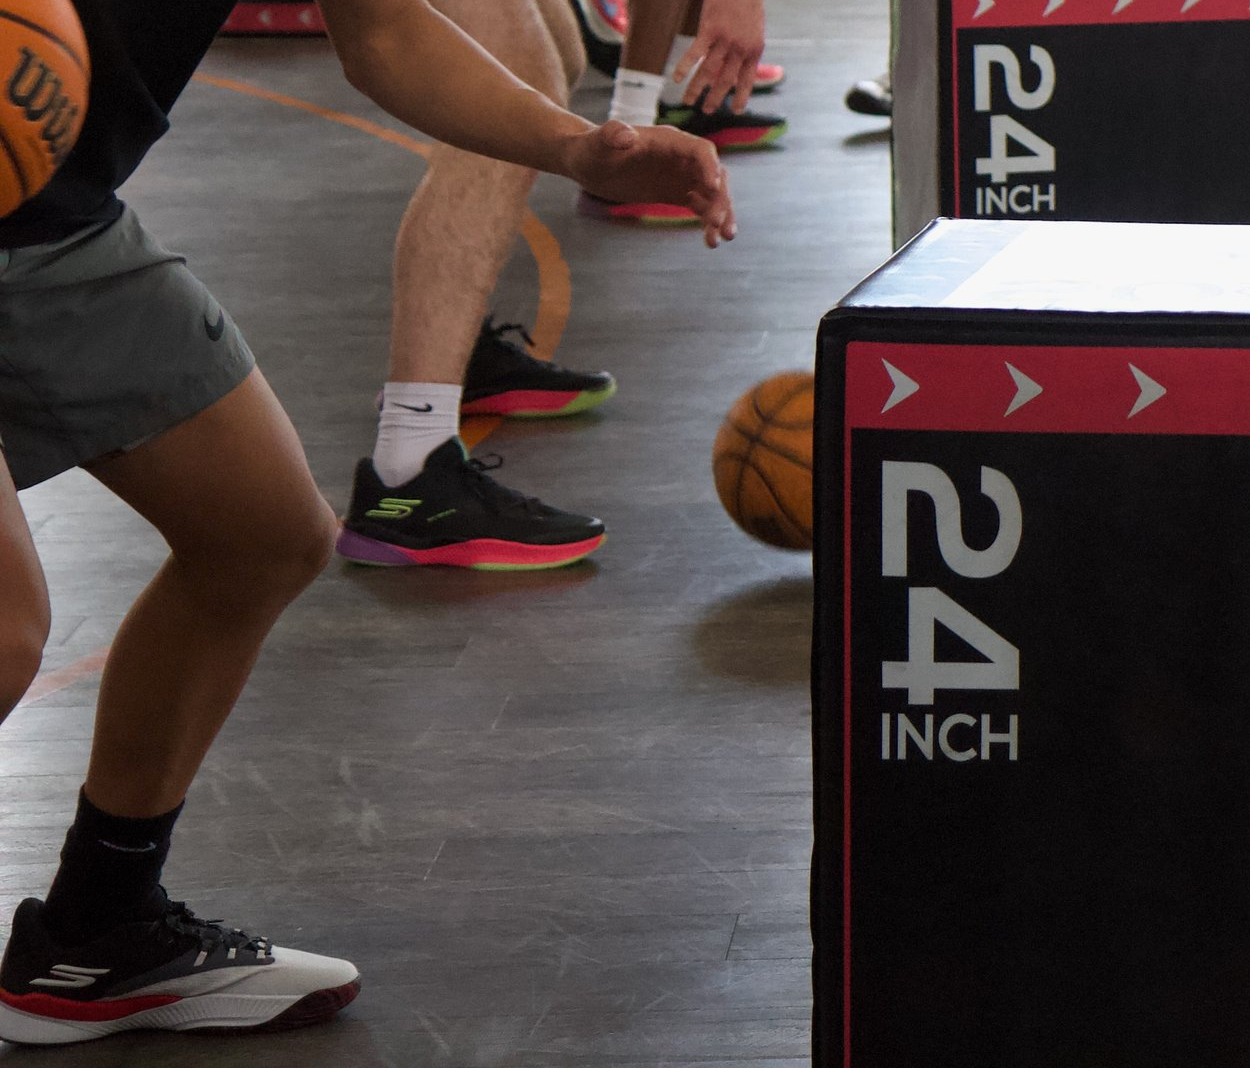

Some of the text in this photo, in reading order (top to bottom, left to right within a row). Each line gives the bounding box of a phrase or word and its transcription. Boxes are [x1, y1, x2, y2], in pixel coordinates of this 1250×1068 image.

[974, 44, 1055, 183] 24
[976, 185, 1055, 215] INCH
[882, 460, 1022, 705] 24
[882, 713, 1018, 761] INCH
